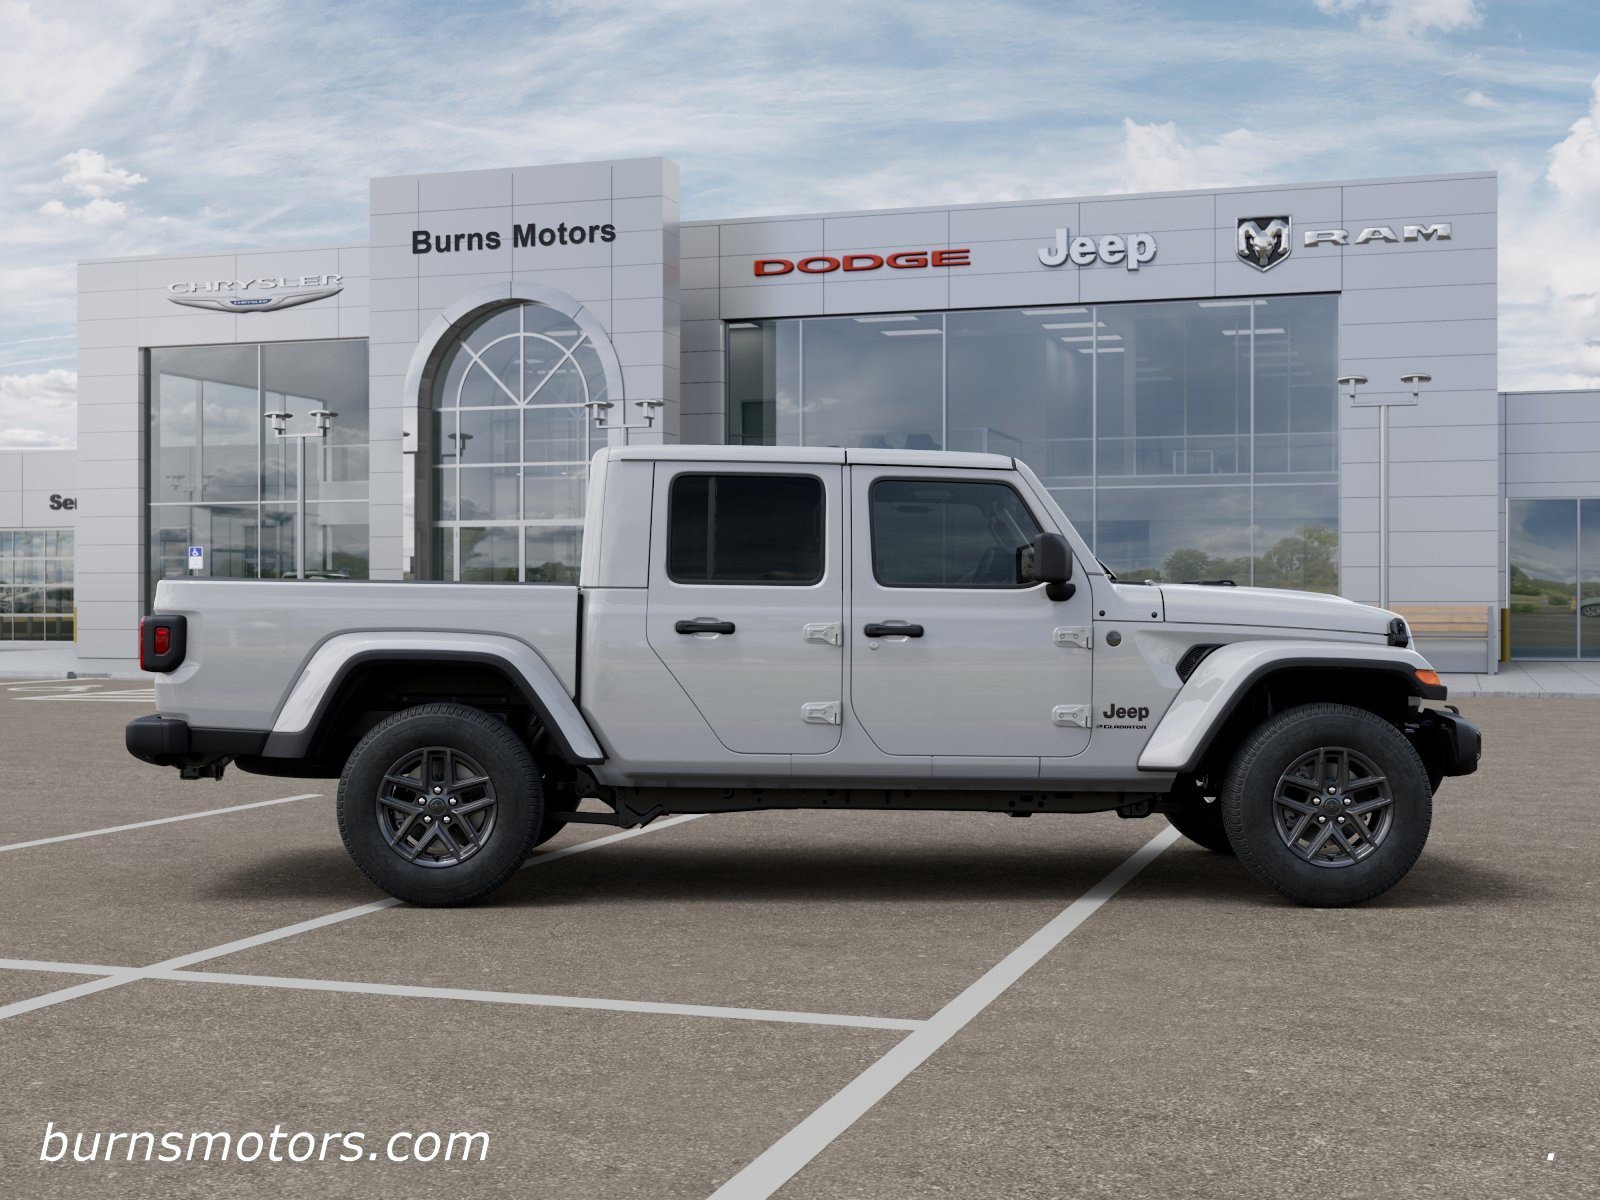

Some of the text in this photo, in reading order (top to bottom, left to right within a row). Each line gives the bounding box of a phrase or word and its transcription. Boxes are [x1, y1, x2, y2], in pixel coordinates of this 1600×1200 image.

[412, 221, 616, 254] Burns Motors
[1304, 223, 1451, 247] RAM
[1038, 227, 1157, 271] Jeep
[754, 248, 970, 276] DODGE
[168, 274, 344, 293] CHRYSLER
[49, 493, 78, 511] Se
[1103, 703, 1149, 721] Jeep
